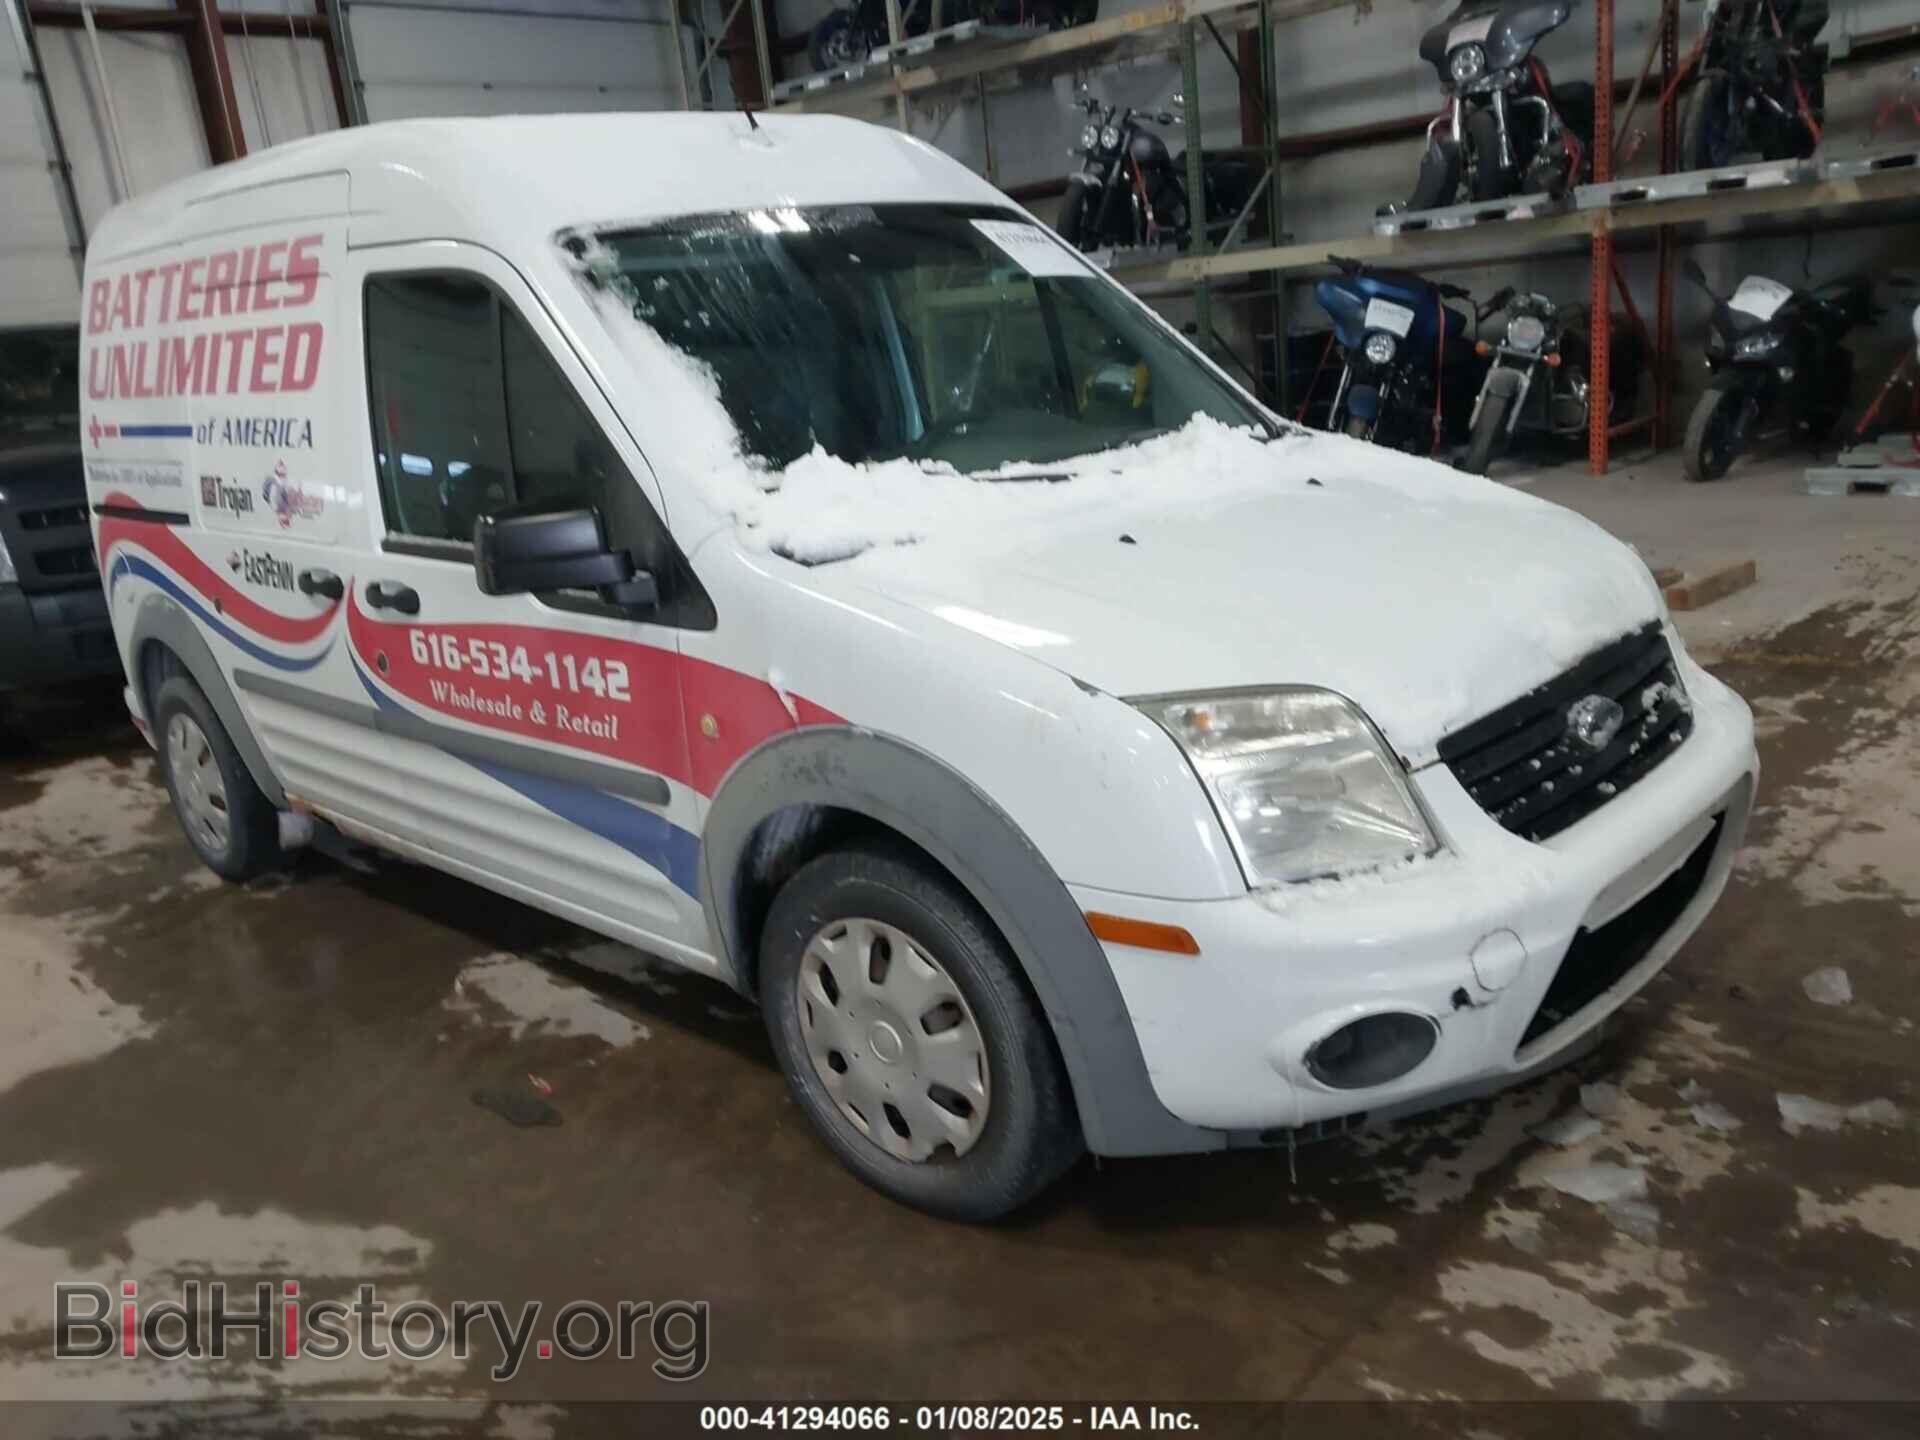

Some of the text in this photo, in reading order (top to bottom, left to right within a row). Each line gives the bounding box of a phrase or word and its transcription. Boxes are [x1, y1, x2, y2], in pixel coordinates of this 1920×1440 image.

[88, 234, 324, 336] BATTERIES
[87, 322, 324, 400] UNLIMITED
[196, 417, 313, 448] of AMERICA
[216, 477, 254, 521] Trojan
[409, 629, 631, 702] 616-534-1142
[430, 679, 619, 741] Wholesale & Retail
